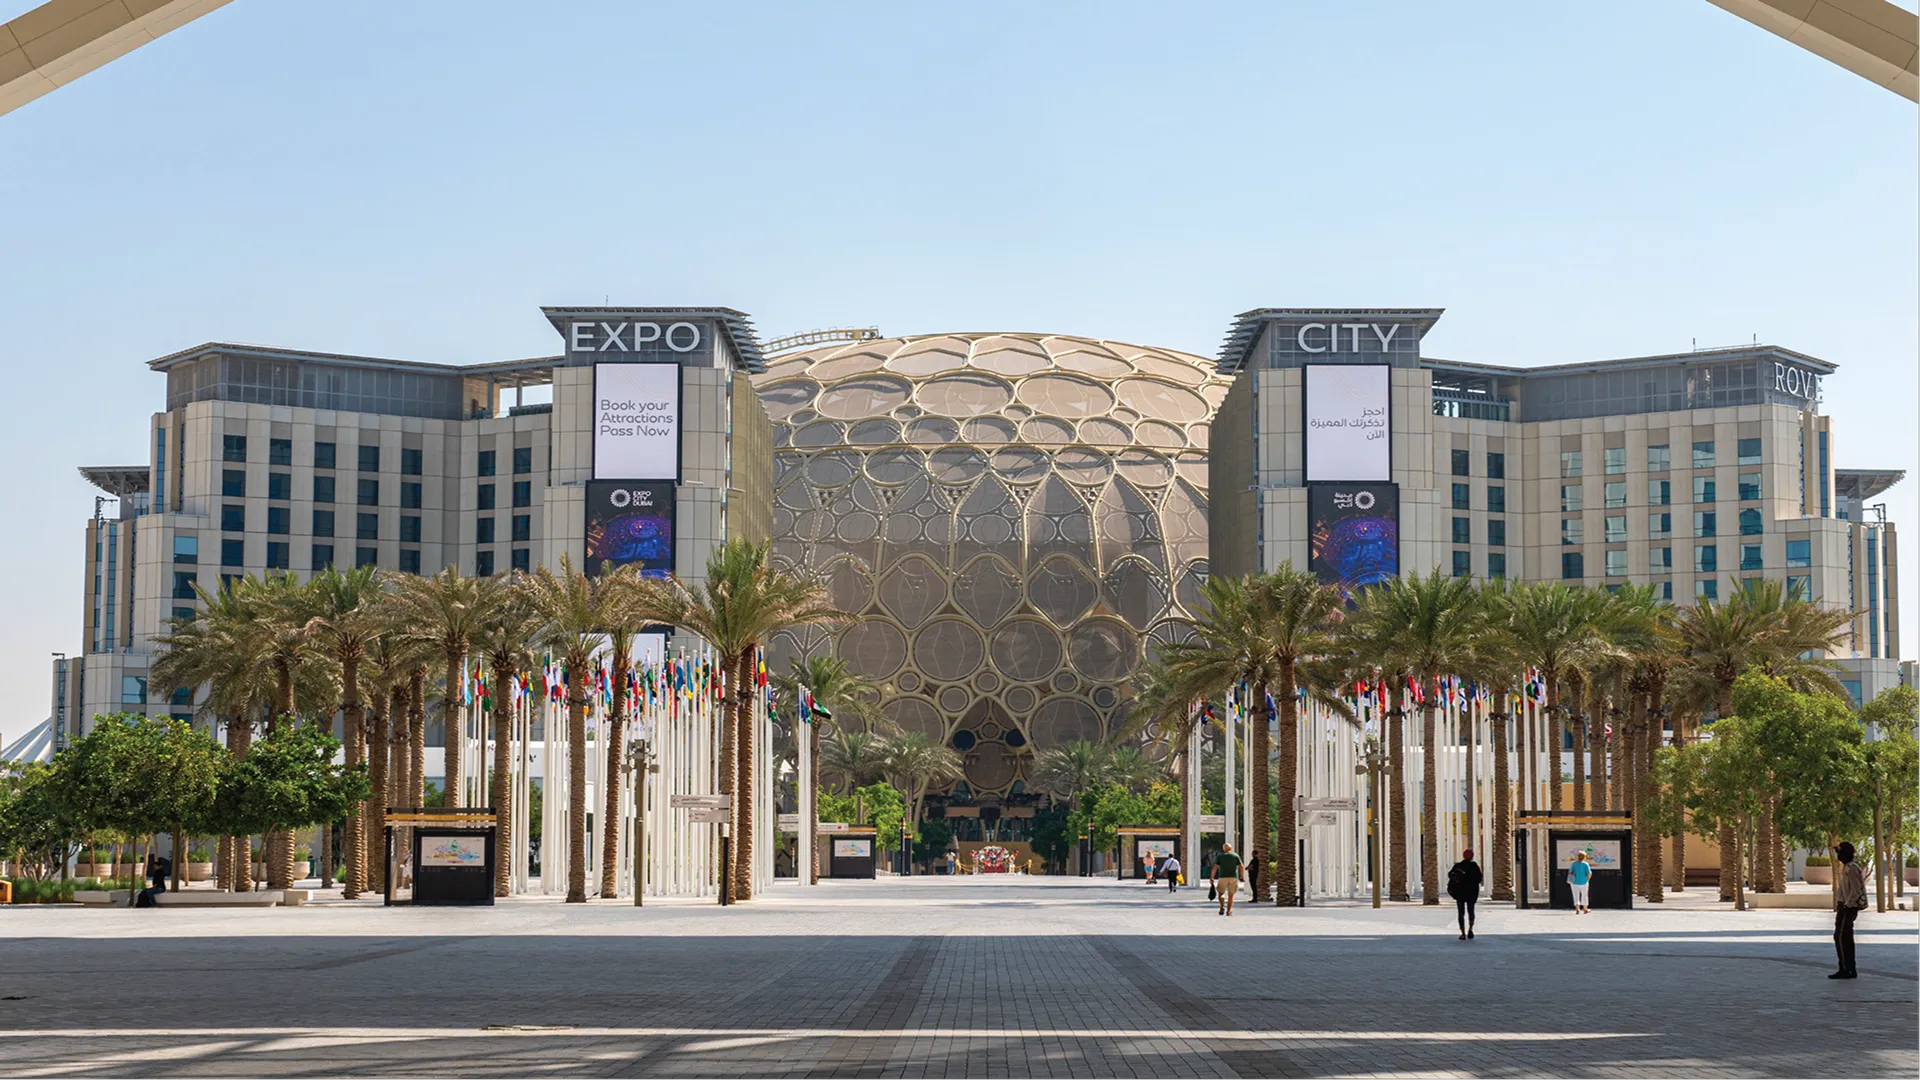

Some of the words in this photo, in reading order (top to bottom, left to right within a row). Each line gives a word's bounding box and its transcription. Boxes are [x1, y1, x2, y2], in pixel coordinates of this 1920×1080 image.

[572, 322, 700, 352] EXPO
[1298, 323, 1400, 353] CITY
[601, 400, 636, 411] Book
[639, 402, 669, 413] your
[600, 412, 674, 423] Attractions
[1361, 407, 1385, 418] احجز
[1310, 418, 1347, 429] المميزة
[1348, 418, 1385, 429] تذكرتك
[600, 425, 633, 436] Pass
[637, 425, 670, 436] Now
